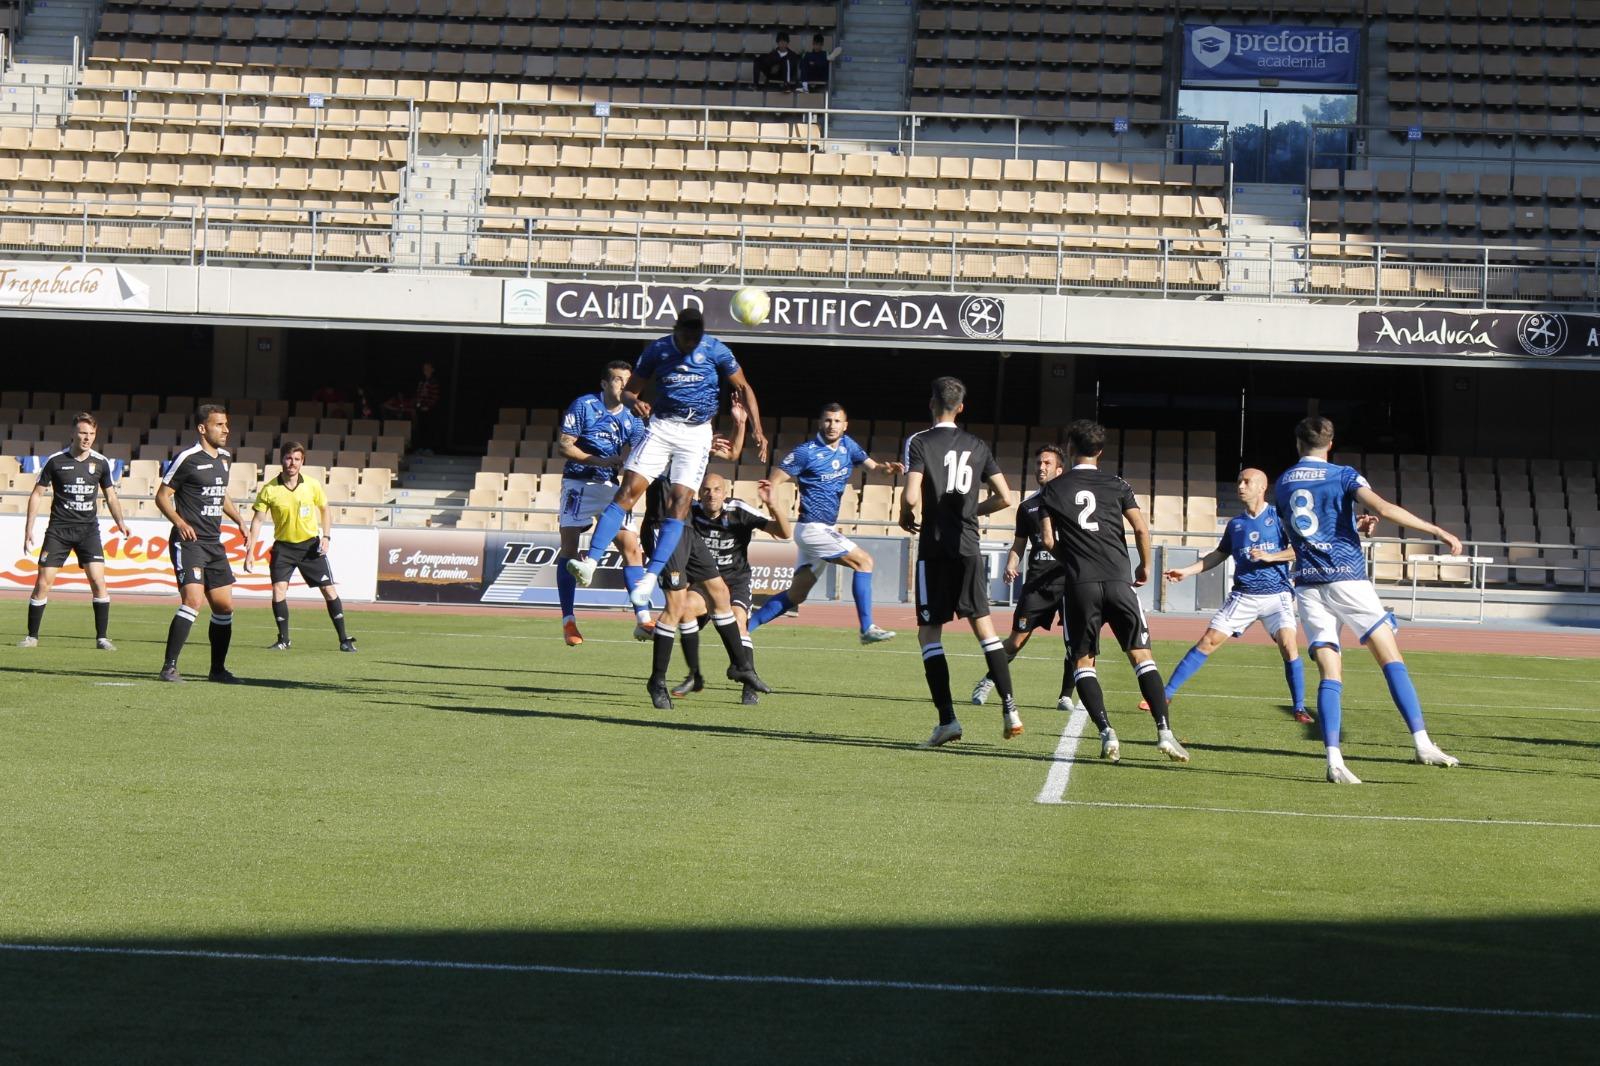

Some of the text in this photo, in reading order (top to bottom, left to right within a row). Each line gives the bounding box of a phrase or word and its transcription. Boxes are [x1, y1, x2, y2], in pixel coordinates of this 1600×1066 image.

[1234, 30, 1349, 56] prefortia
[1257, 55, 1326, 69] academia
[556, 289, 705, 321] CALIDAD
[730, 297, 948, 330] RTIFICADA
[1375, 315, 1499, 349] Andalucía
[1586, 327, 1599, 347] A
[943, 450, 973, 494] 16
[63, 484, 95, 494] XEREZ
[1074, 489, 1100, 532] 2
[1289, 488, 1320, 537] 8
[701, 537, 735, 550] EREZ
[388, 548, 402, 565] Te
[404, 568, 418, 578] en
[750, 566, 795, 579] 270 533
[771, 579, 793, 591] 079
